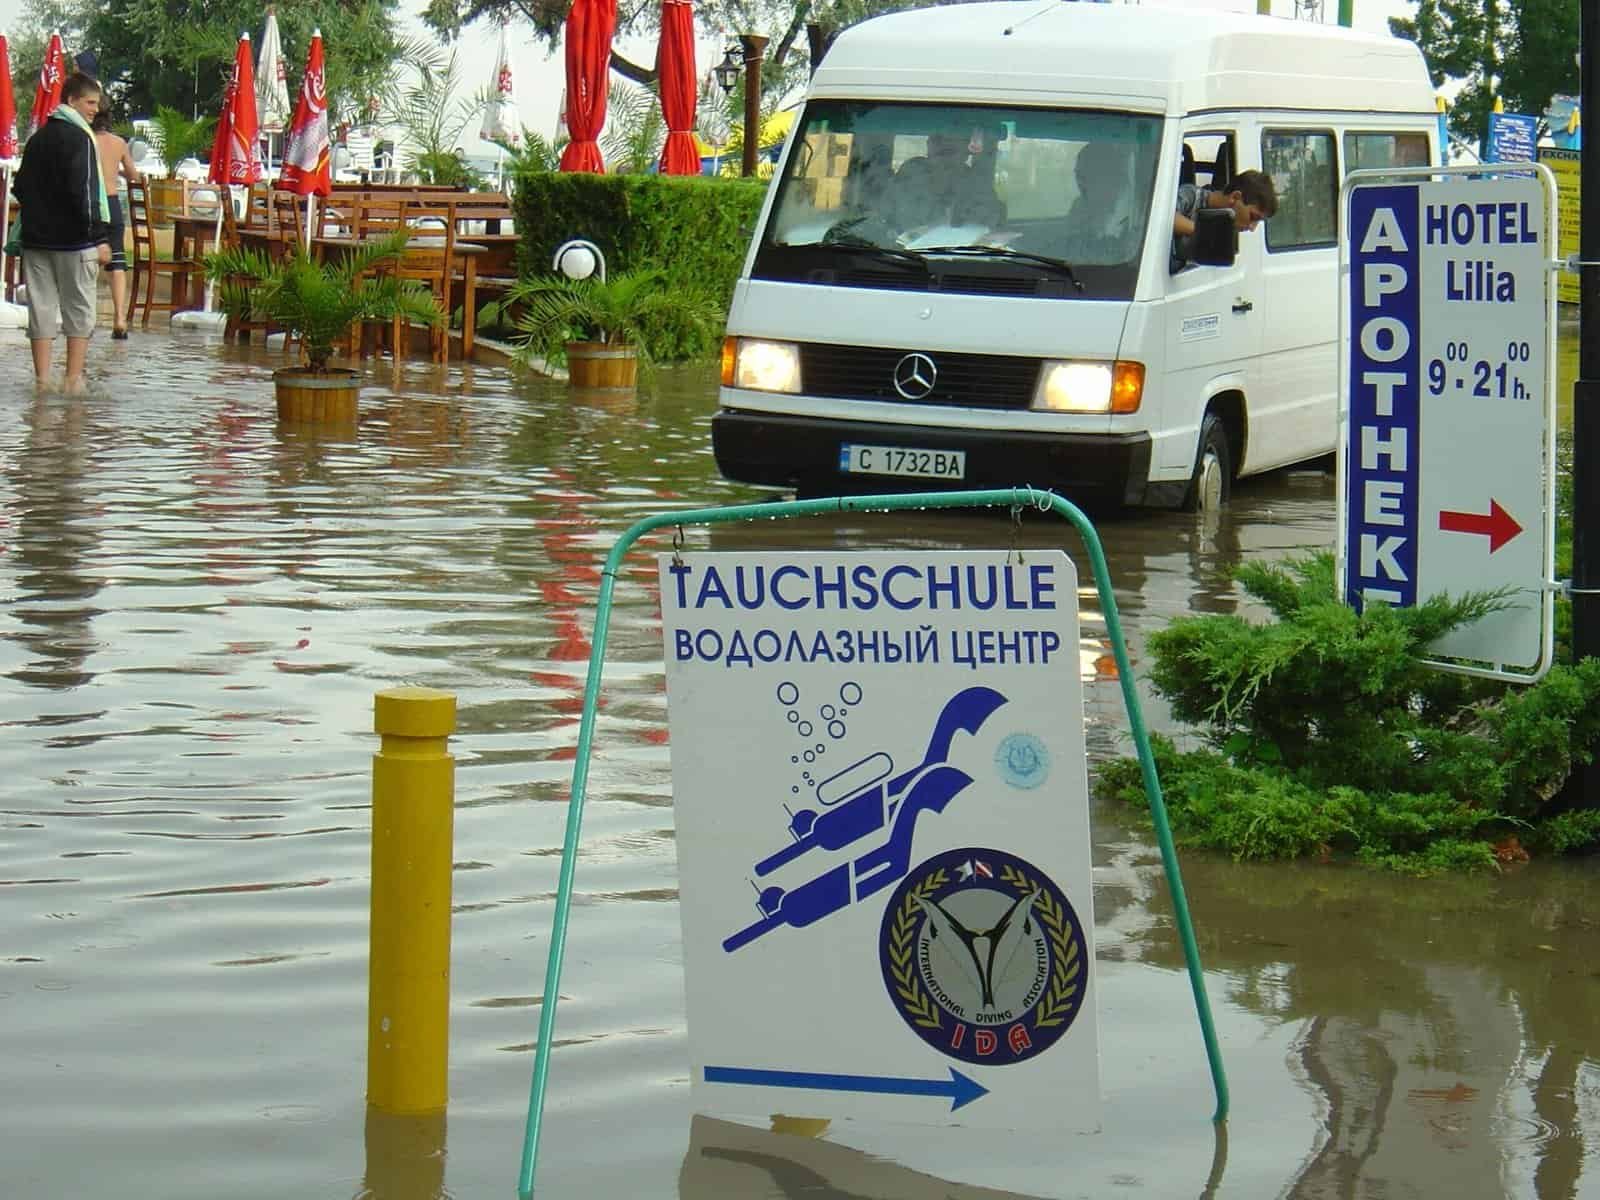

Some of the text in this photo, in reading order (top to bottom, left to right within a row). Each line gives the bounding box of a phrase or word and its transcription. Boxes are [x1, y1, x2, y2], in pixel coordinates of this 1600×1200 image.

[1426, 202, 1538, 245] HOTEL
[1447, 260, 1516, 302] Lilia
[859, 449, 873, 470] C
[669, 564, 1057, 610] TAUCHSCHULE
[675, 625, 1061, 669] ВОДОЛАЗНЫЙ ЦЕНТР
[919, 937, 1048, 1024] INTERNATIONAL DIVING ASSOCIATION
[951, 1023, 1033, 1056] IDA
